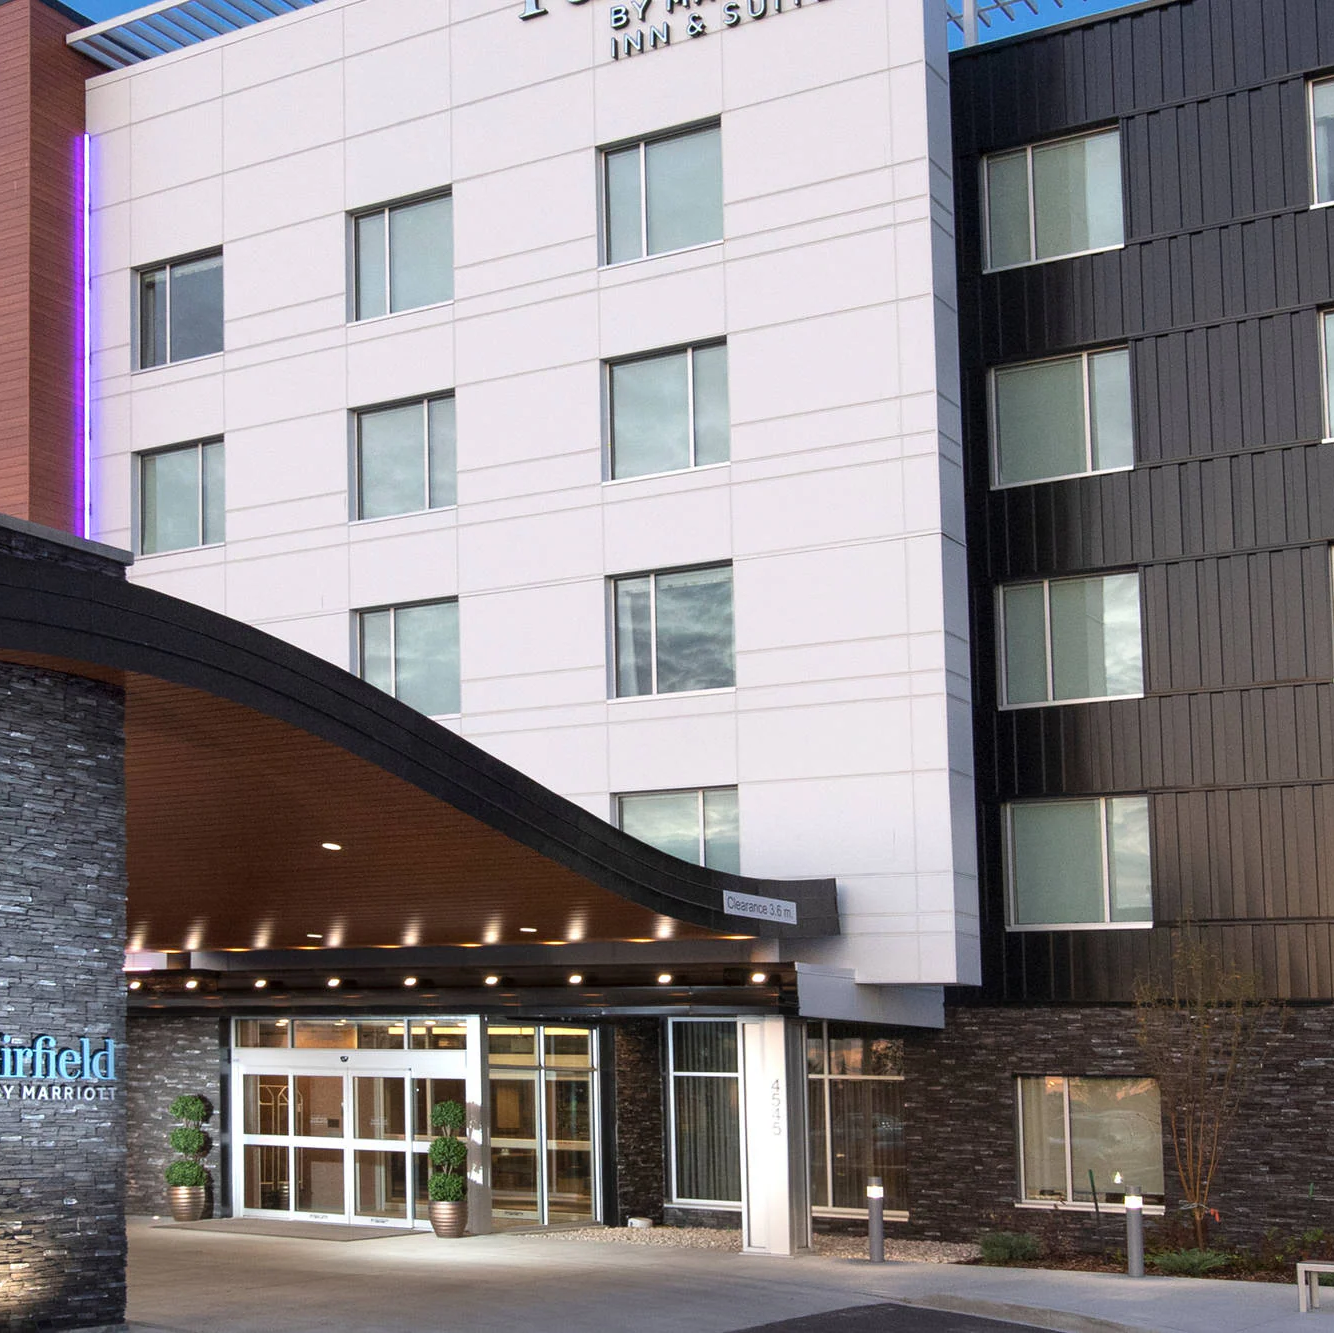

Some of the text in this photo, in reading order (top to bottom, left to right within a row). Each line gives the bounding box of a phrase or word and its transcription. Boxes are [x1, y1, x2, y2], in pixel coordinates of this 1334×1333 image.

[611, 0, 650, 29] BY
[611, 21, 670, 60] INN
[686, 12, 707, 38] &
[727, 896, 768, 915] Clearance
[769, 903, 782, 917] 3.6
[22, 1085, 117, 1101] MARRIOTT
